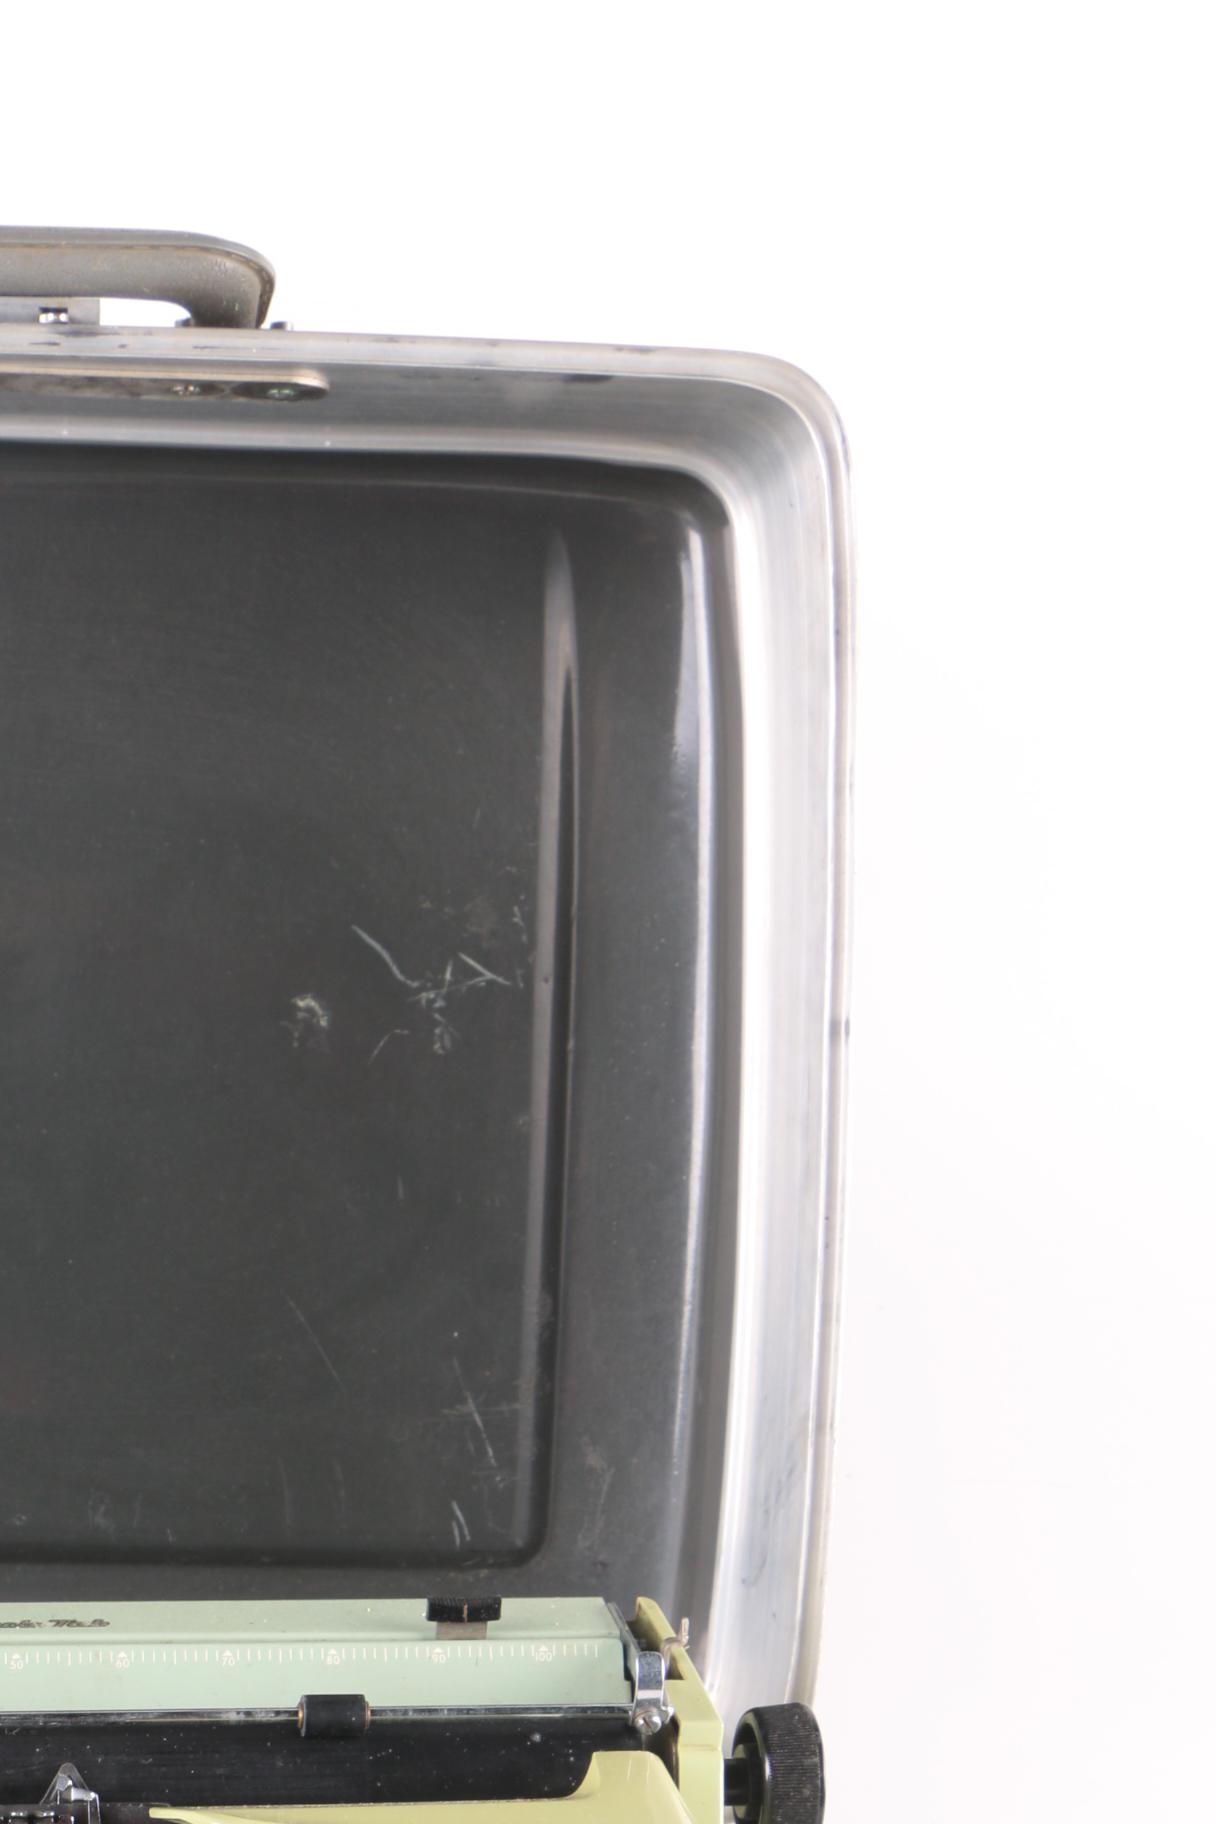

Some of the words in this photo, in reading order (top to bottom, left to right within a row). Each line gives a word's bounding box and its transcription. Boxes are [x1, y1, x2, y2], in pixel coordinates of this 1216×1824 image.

[9, 1659, 24, 1670] 50
[115, 1658, 130, 1670] 60
[221, 1655, 236, 1666] 70
[326, 1654, 341, 1665] 80
[431, 1652, 447, 1664] 90
[535, 1651, 553, 1662] 100
